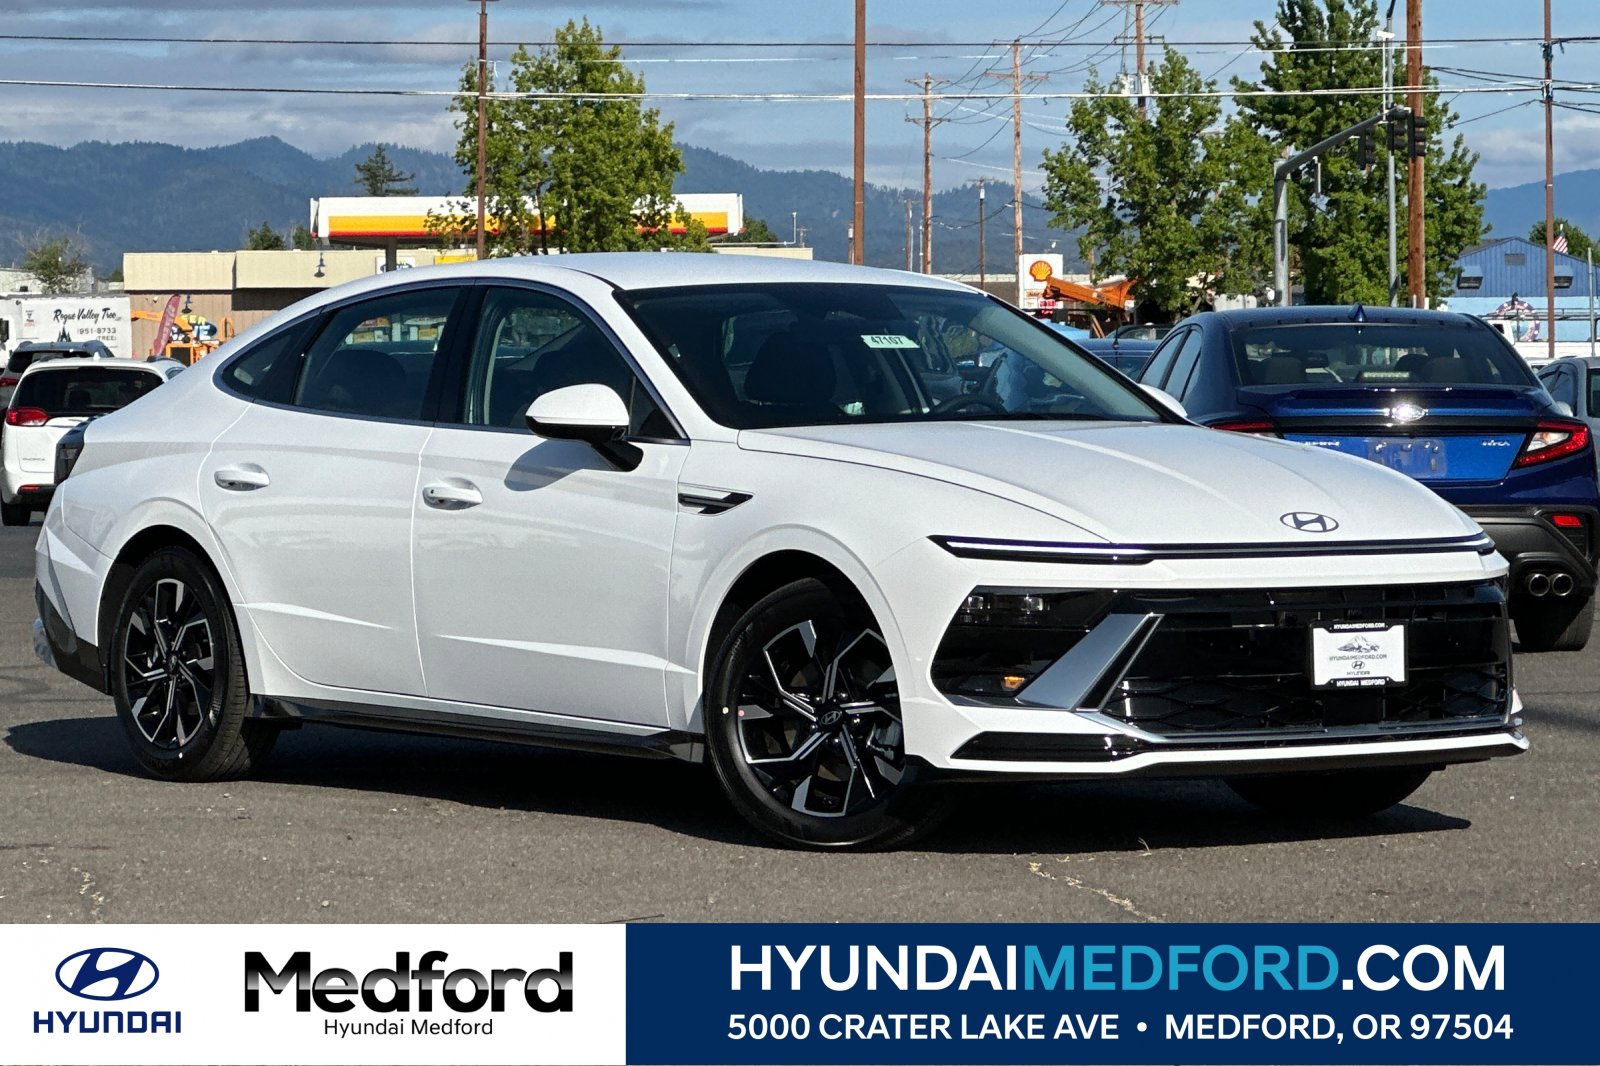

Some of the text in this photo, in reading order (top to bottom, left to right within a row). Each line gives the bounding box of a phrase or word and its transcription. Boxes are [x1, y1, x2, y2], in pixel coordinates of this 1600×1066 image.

[53, 308, 76, 325] Rogue
[77, 307, 100, 324] Valley
[101, 307, 117, 320] Tree
[1329, 653, 1387, 661] HYUNDAIMEDFORD.COM
